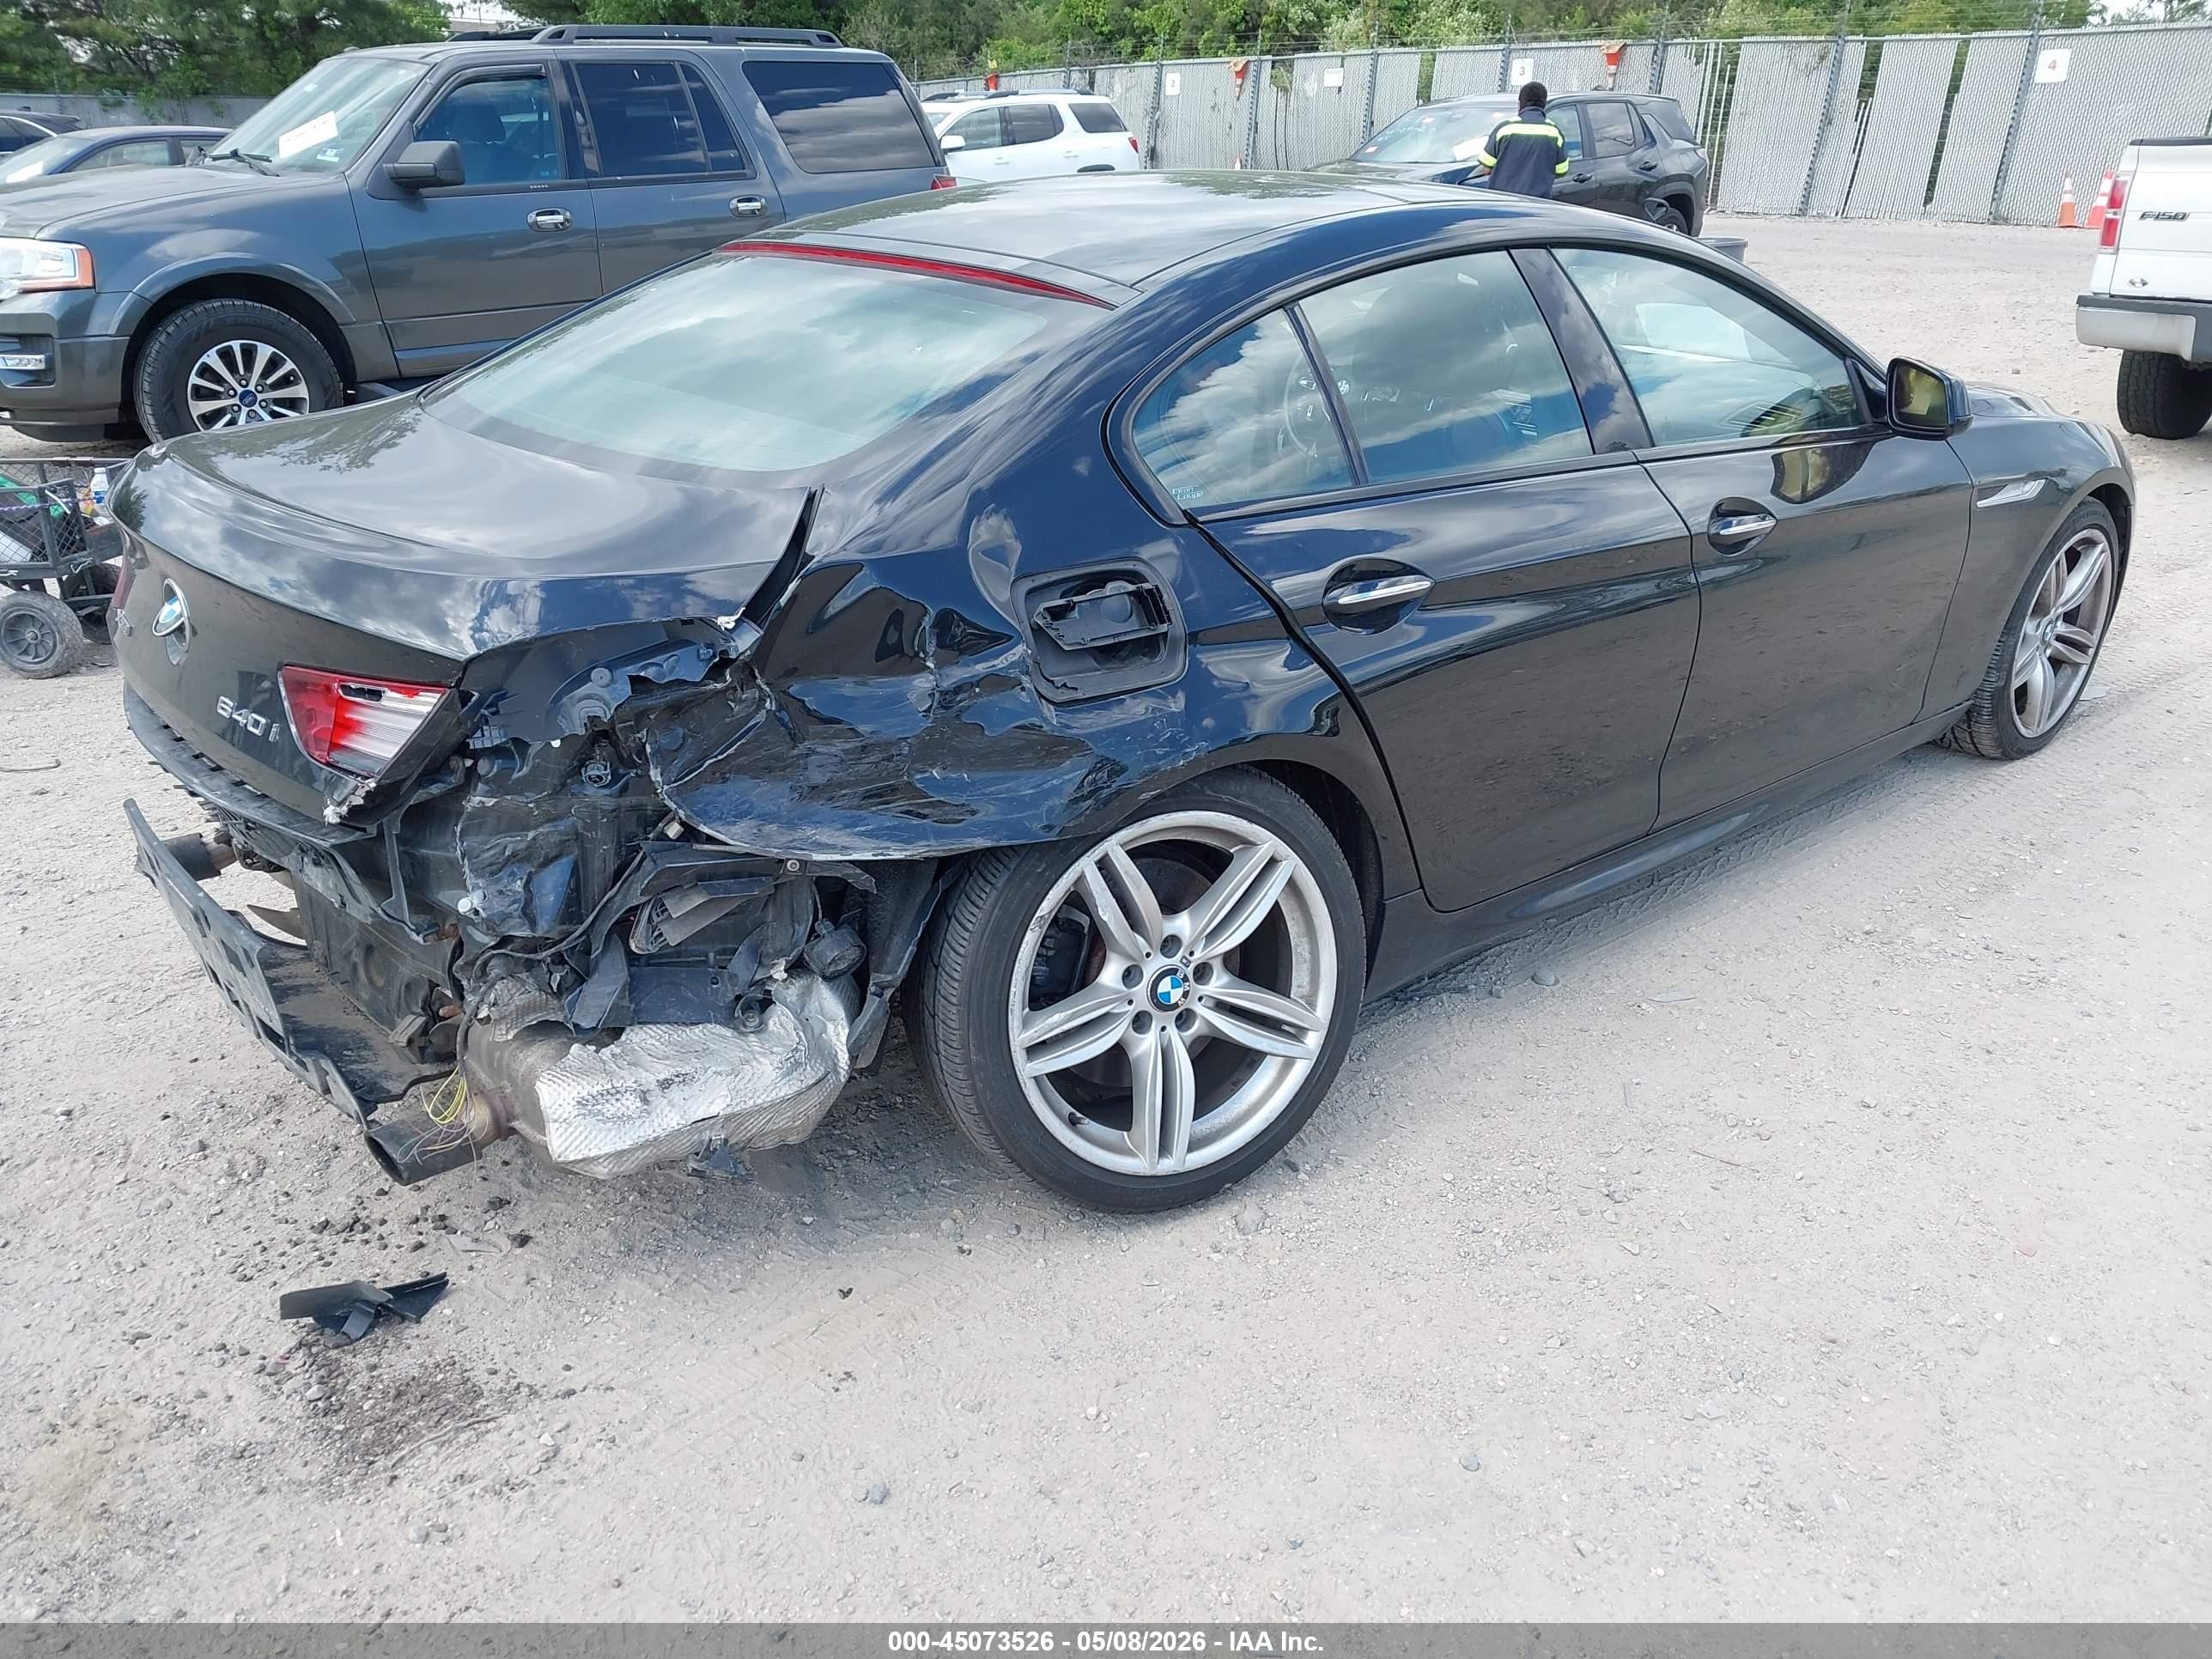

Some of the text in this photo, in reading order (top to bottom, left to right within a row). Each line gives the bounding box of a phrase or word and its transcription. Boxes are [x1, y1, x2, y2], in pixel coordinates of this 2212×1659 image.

[2047, 59, 2057, 70] 4
[1519, 66, 1525, 76] 3
[1170, 79, 1176, 88] 2
